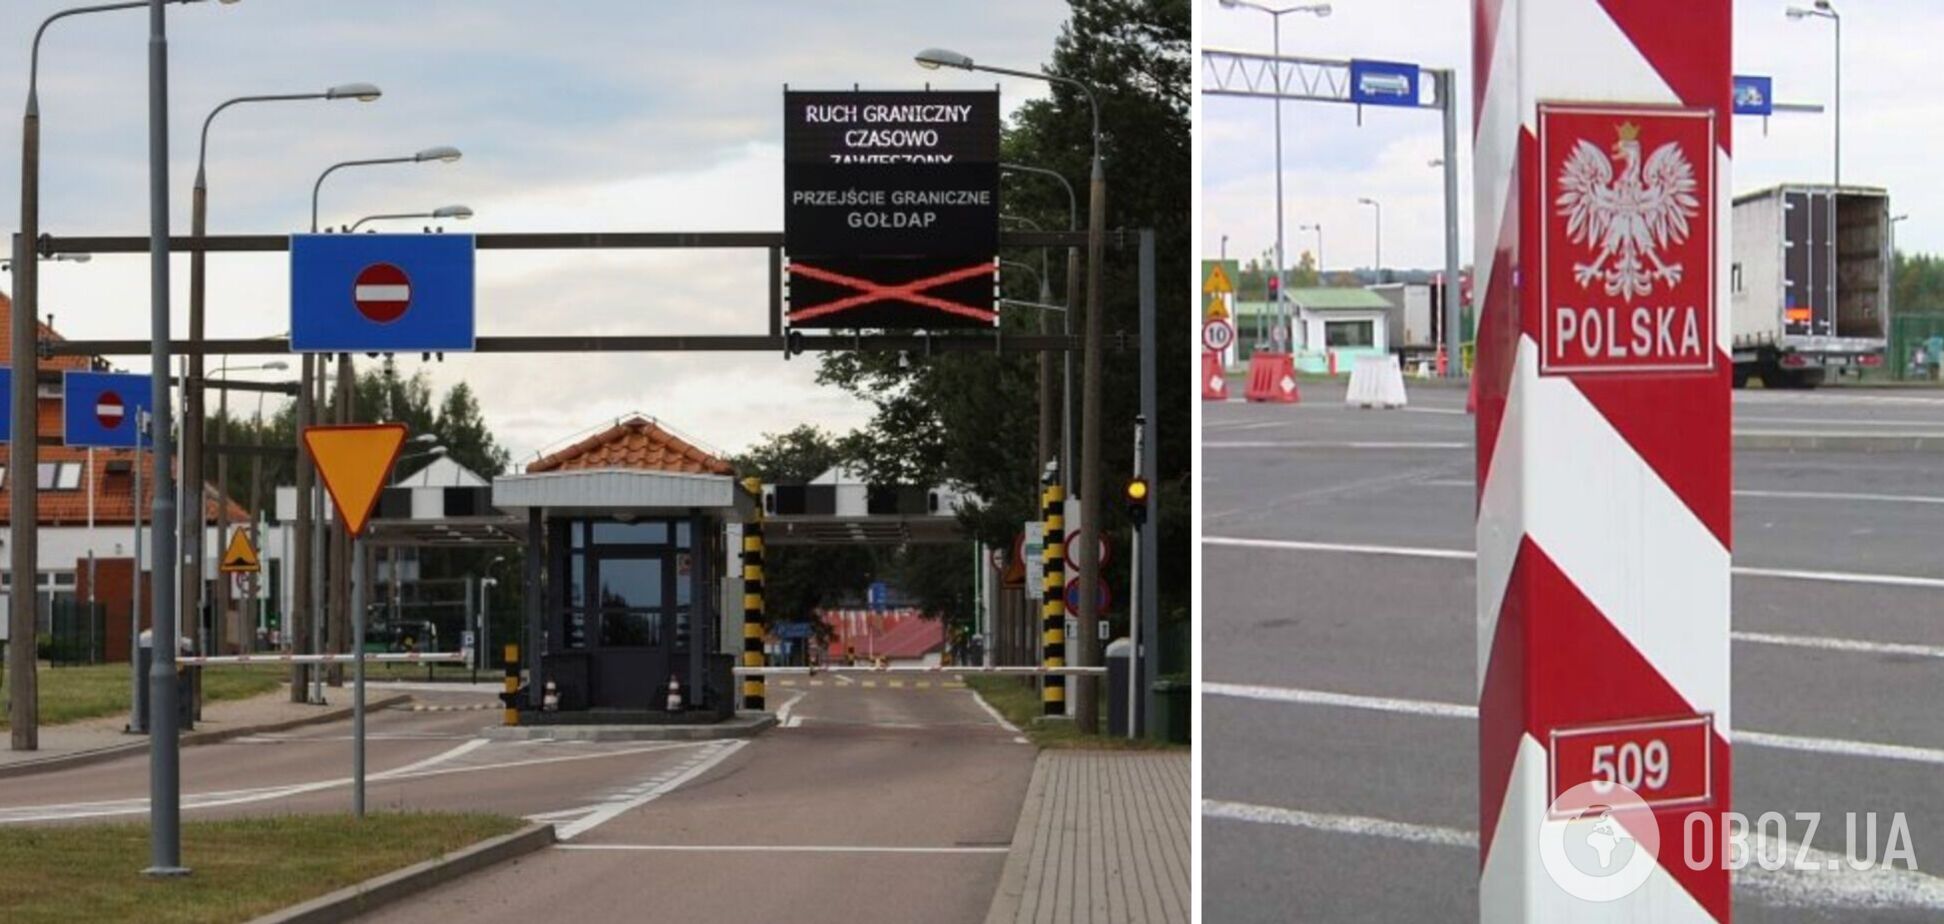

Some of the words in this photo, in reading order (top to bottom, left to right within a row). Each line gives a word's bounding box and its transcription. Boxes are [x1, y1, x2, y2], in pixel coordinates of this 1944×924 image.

[805, 105, 858, 122] RUCH
[863, 105, 972, 122] GRANICZNY
[845, 129, 938, 147] CZASOWO
[793, 186, 885, 205] PRZEJŚCIE
[891, 191, 990, 205] GRANICZNE
[847, 212, 937, 228] GOŁDAP
[1210, 327, 1226, 343] 10
[1556, 307, 1701, 358] POLSKA
[1591, 739, 1669, 794] 509
